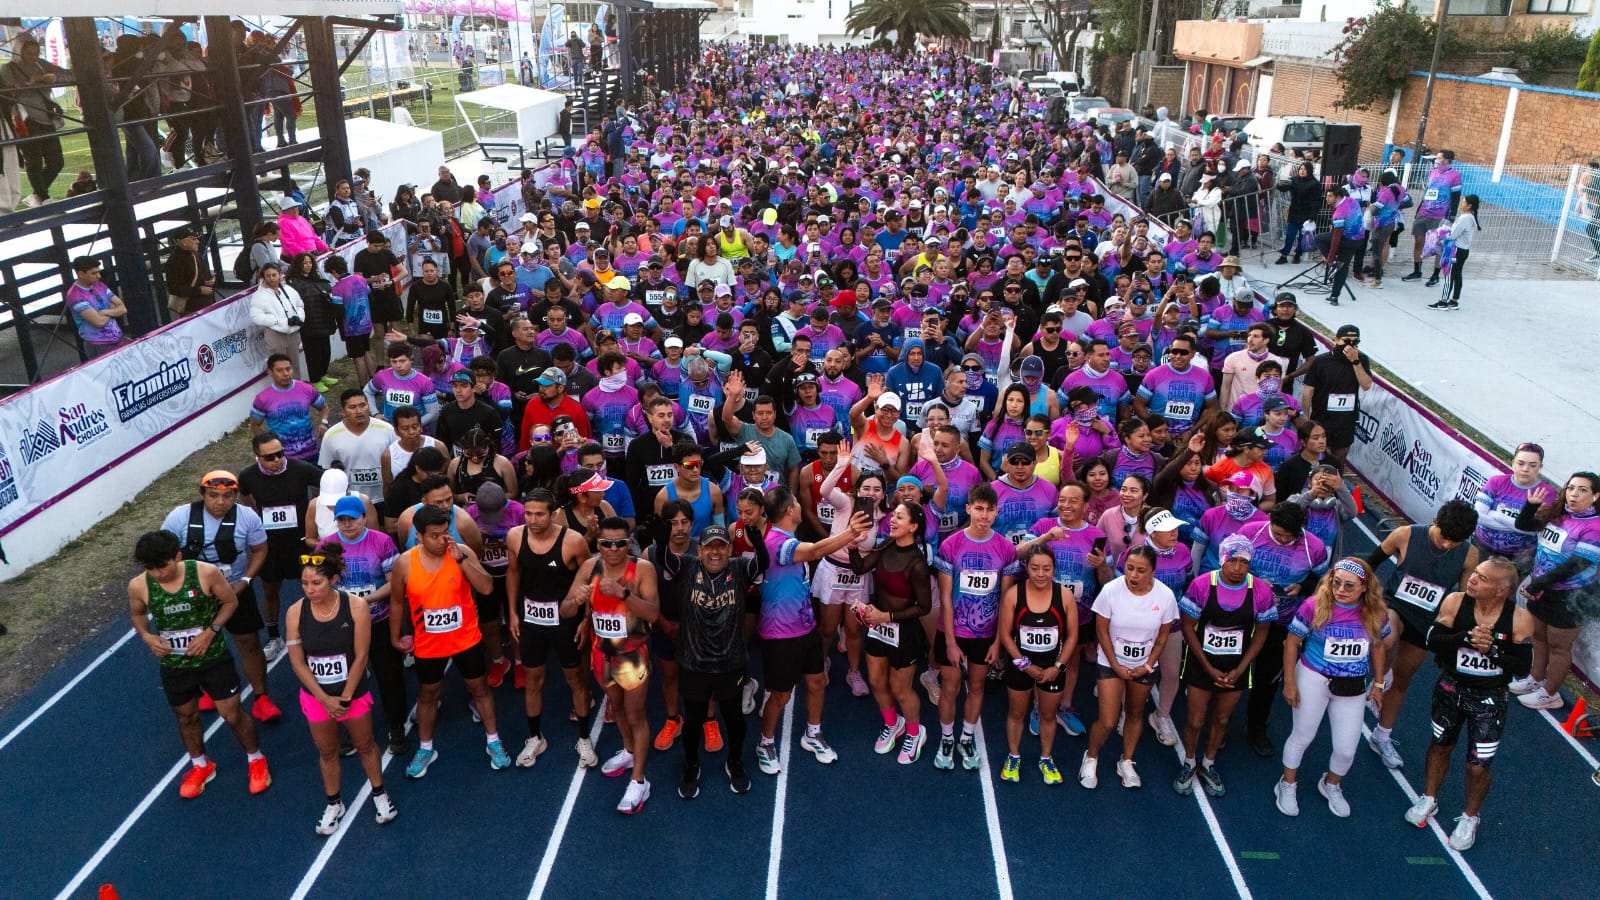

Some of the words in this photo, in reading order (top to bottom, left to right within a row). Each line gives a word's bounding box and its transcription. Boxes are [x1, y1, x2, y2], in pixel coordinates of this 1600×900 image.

[216, 337, 248, 365] ALVART
[114, 358, 190, 411] Fleming
[120, 399, 147, 421] FARMACIAS
[145, 382, 186, 408] UNIVERSITARIAS
[389, 392, 411, 404] 1659
[692, 398, 710, 410] 903
[1337, 397, 1347, 407] 77
[58, 402, 87, 424] San
[1168, 404, 1191, 415] 1033
[60, 408, 106, 446] Andrés
[76, 422, 110, 445] CHOLULA
[607, 437, 625, 447] 529
[1412, 440, 1433, 467] San
[354, 472, 379, 482] 1352
[649, 468, 675, 480] 2279
[1403, 451, 1441, 491] Andrés
[1410, 474, 1437, 502] CHOLULA
[272, 510, 287, 522] 88
[967, 575, 989, 588] 789
[1403, 581, 1437, 603] 1506
[526, 604, 554, 619] 2308
[427, 614, 458, 626] 2234
[595, 618, 621, 632] 1789
[1026, 632, 1051, 645] 306
[1207, 633, 1237, 648] 2315
[1123, 645, 1145, 657] 961
[1330, 643, 1361, 656] 2110
[310, 661, 343, 677] 2029
